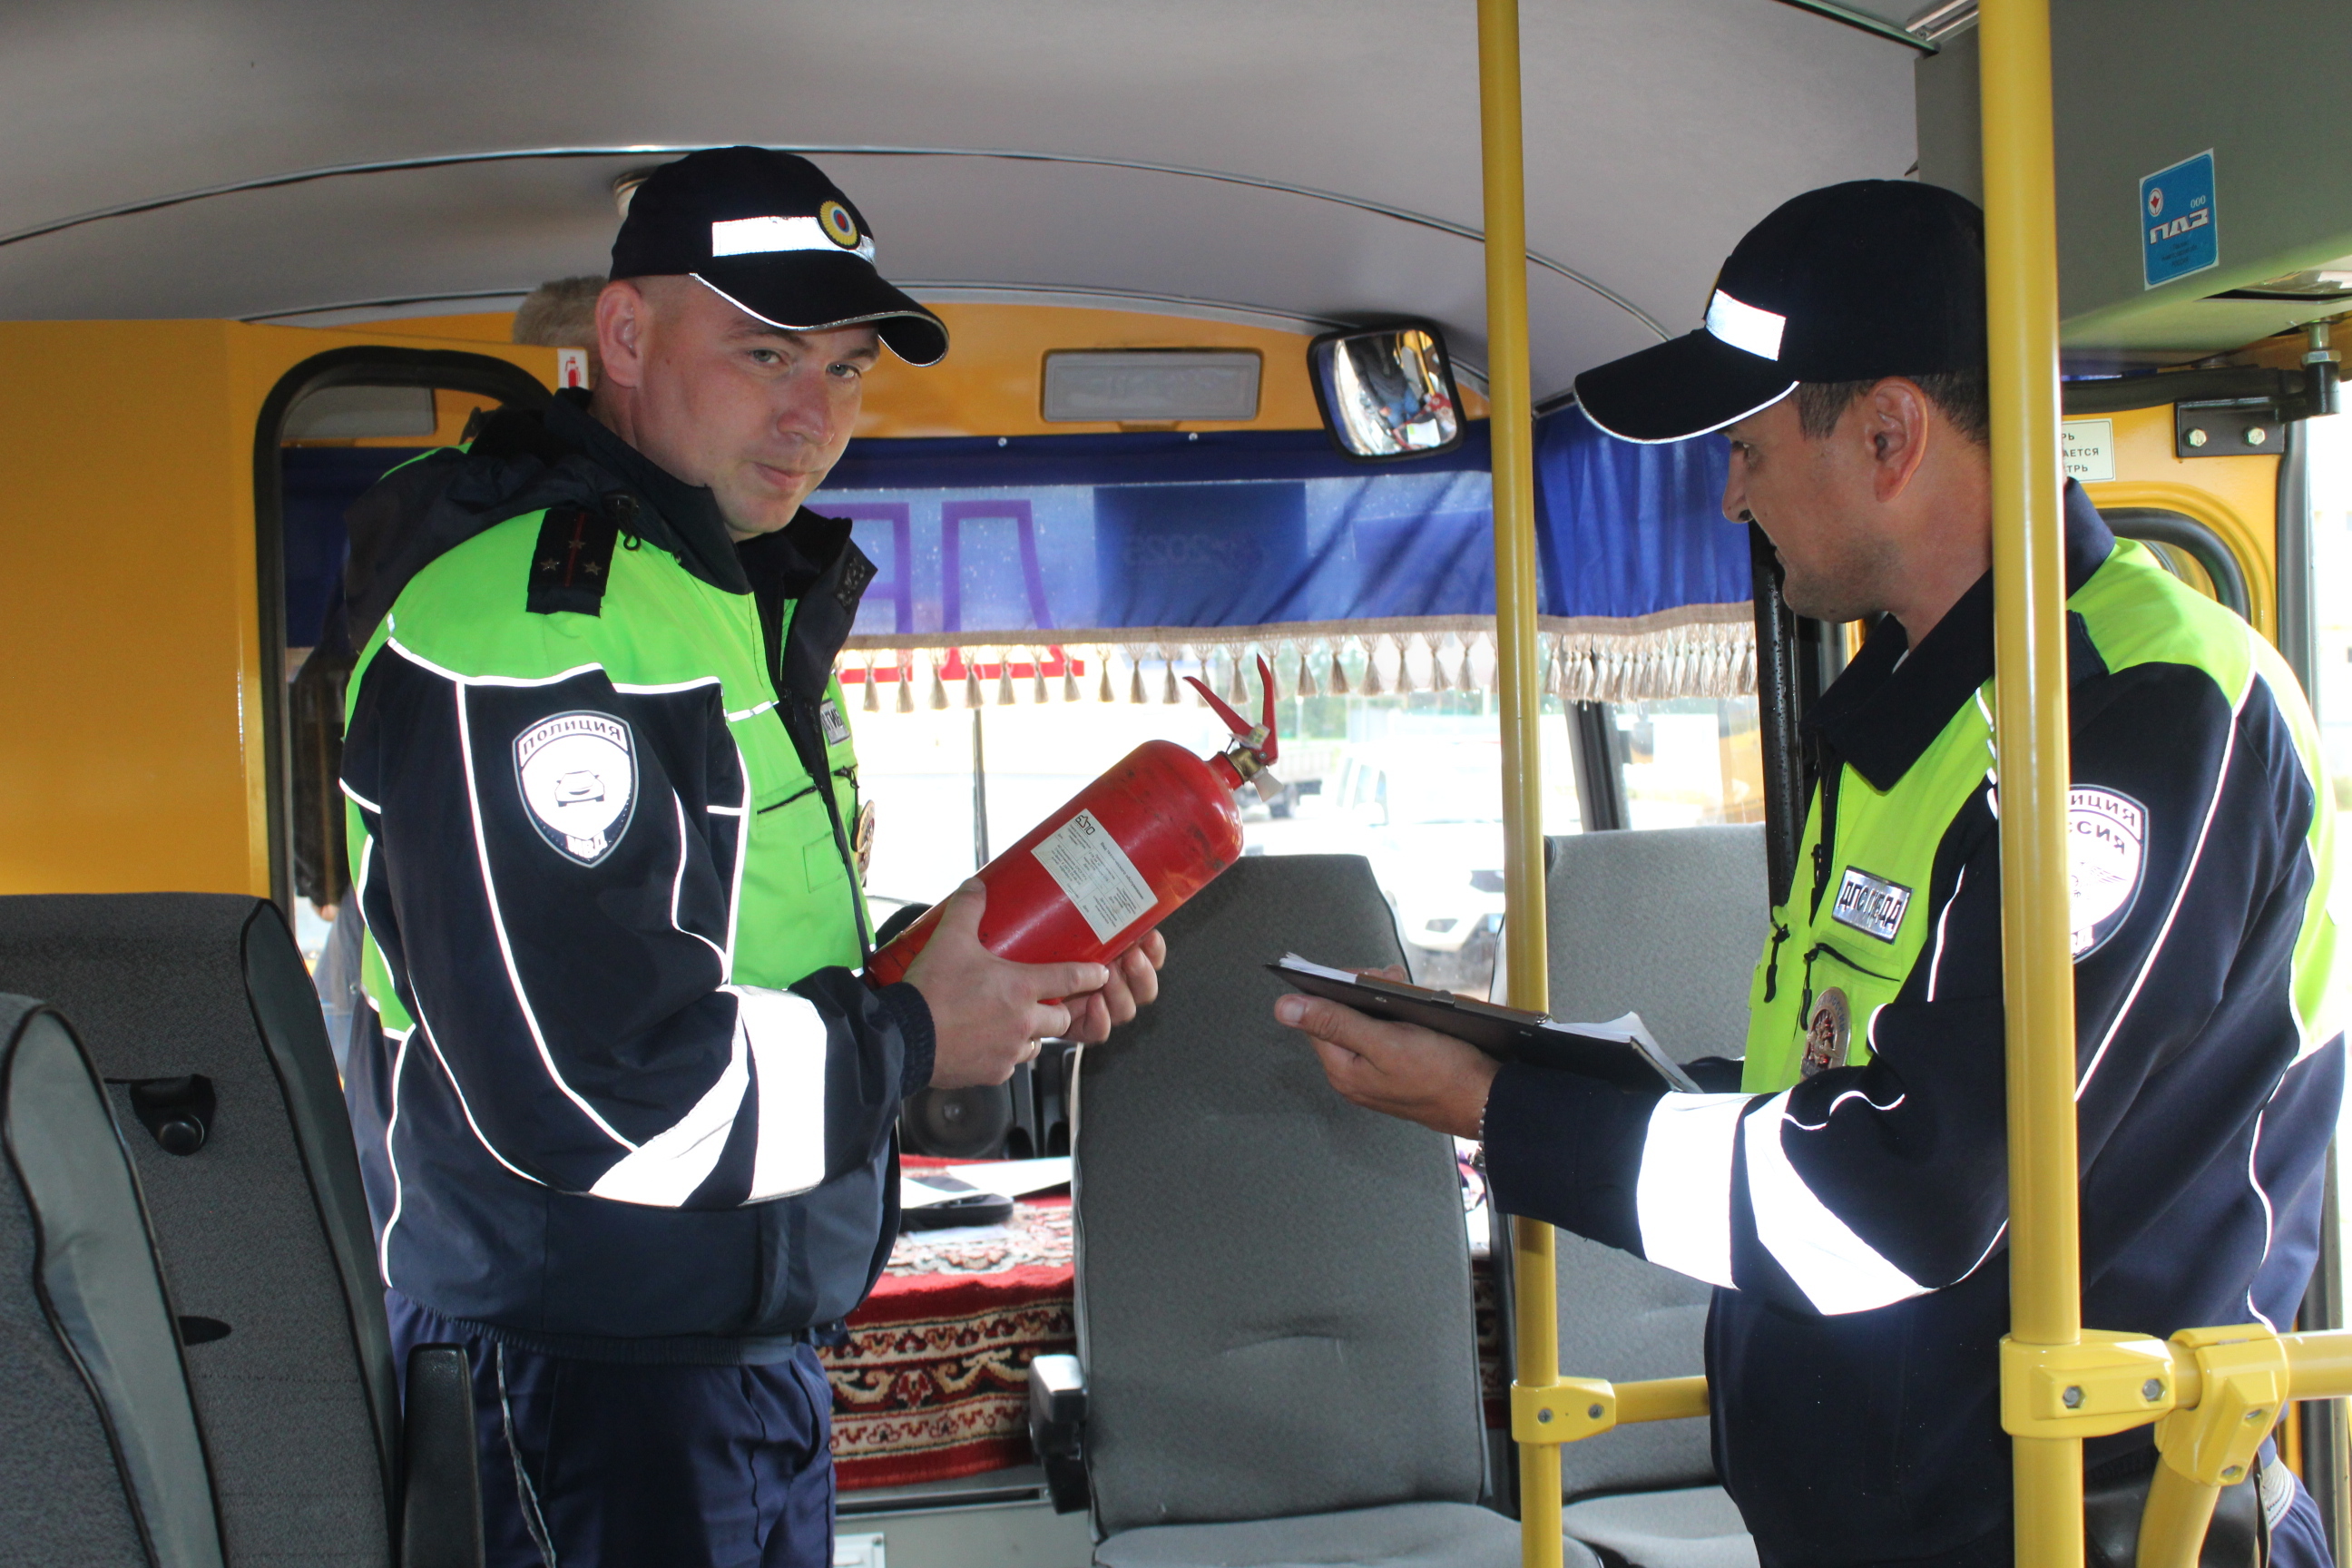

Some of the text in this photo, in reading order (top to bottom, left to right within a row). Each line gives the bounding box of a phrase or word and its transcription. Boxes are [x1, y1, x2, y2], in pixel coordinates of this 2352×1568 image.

[2149, 207, 2210, 245] ПАЗ
[2063, 447, 2099, 457] АЕТСЯ
[2067, 464, 2089, 473] ТРЬ
[523, 720, 622, 755] ПОЛИЦИЯ
[2070, 794, 2135, 828] ИЦИЯ
[2069, 820, 2125, 856] СИЯ
